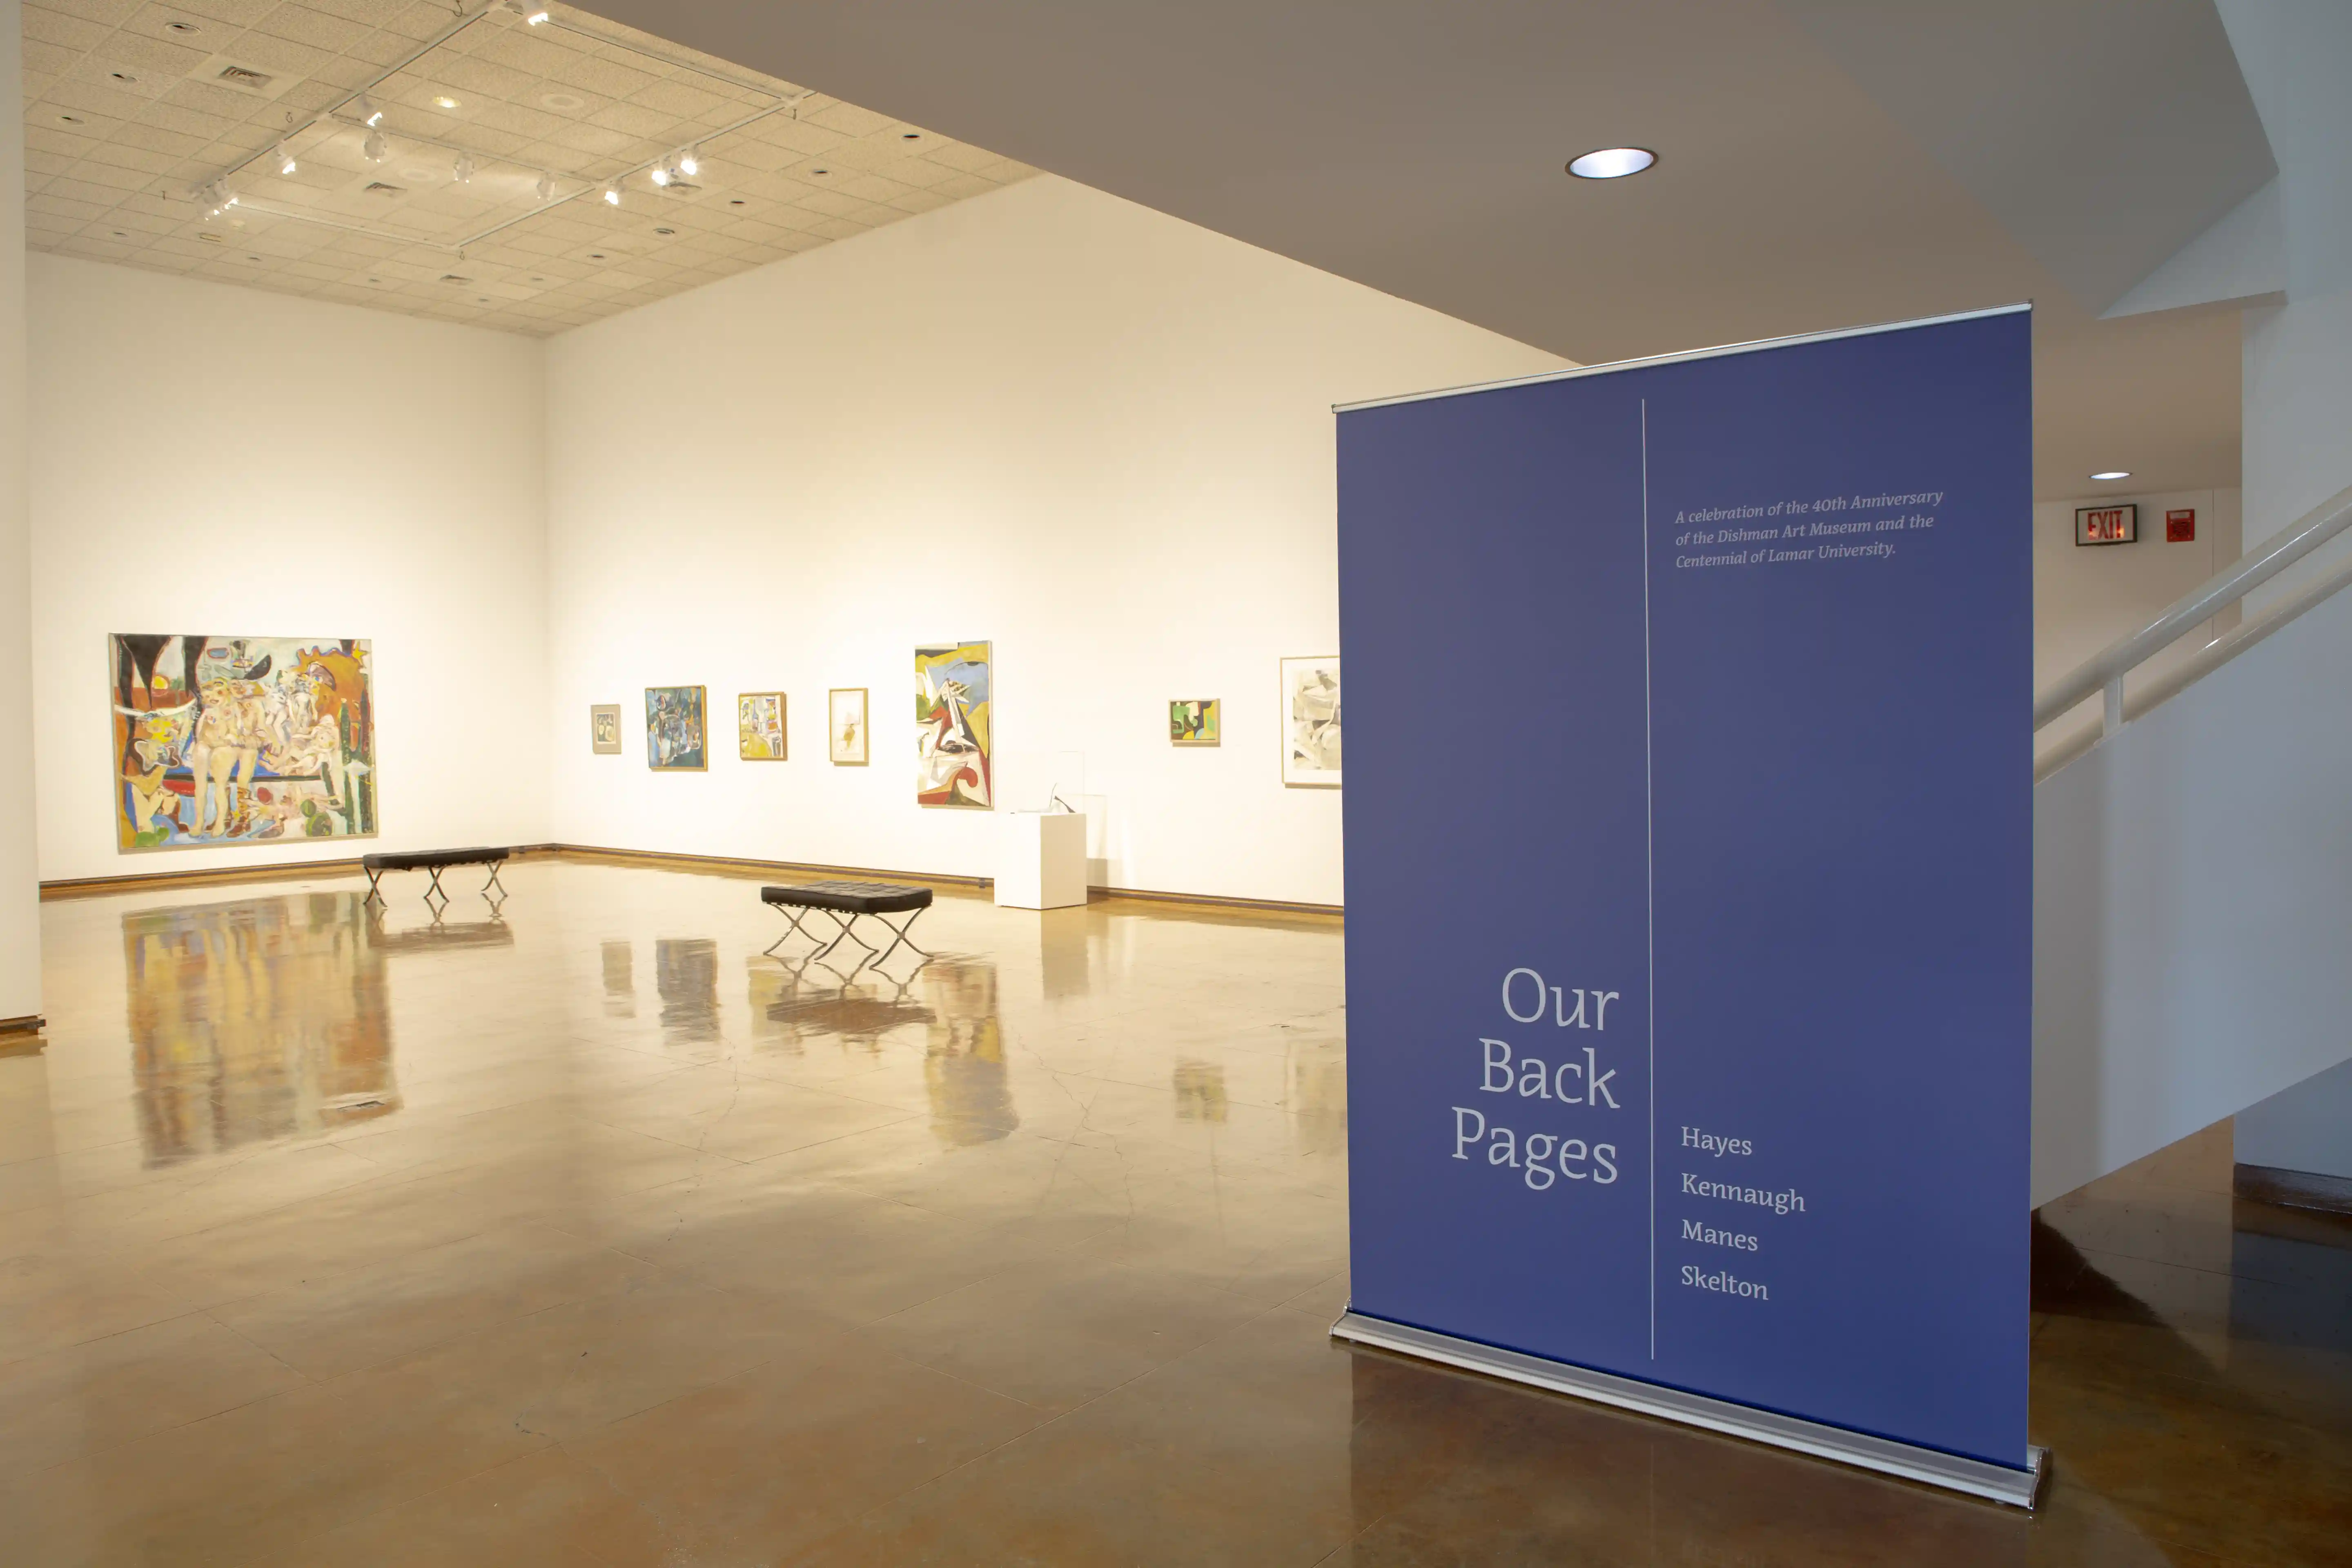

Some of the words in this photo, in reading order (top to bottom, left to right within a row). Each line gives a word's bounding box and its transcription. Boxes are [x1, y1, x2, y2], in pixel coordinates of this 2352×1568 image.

[1675, 511, 1685, 523] A
[1688, 507, 1763, 523] celebration
[1767, 501, 1784, 516] of
[1786, 500, 1809, 514] the
[1812, 496, 1846, 512] 40th
[1850, 491, 1944, 509] Anniversary
[1675, 532, 1690, 546] of
[1693, 531, 1714, 545] the
[1717, 528, 1778, 543] Dishman
[1781, 524, 1806, 538] Art
[1809, 522, 1871, 536] Museum
[1875, 515, 1905, 531] and
[1909, 514, 1934, 528] the
[2087, 510, 2123, 540] EXIT
[1676, 550, 1747, 568] Centennial
[1751, 548, 1766, 563] of
[1768, 549, 1815, 562] Lamar
[1818, 541, 1896, 559] University.
[1502, 967, 1619, 1031] Our
[1479, 1038, 1621, 1109] Back
[1451, 1106, 1618, 1190] Pages
[1681, 1126, 1753, 1158] Hayes
[1681, 1172, 1806, 1215] Kennaugh
[1681, 1219, 1758, 1252] Manes
[1681, 1265, 1769, 1301] Skelton
